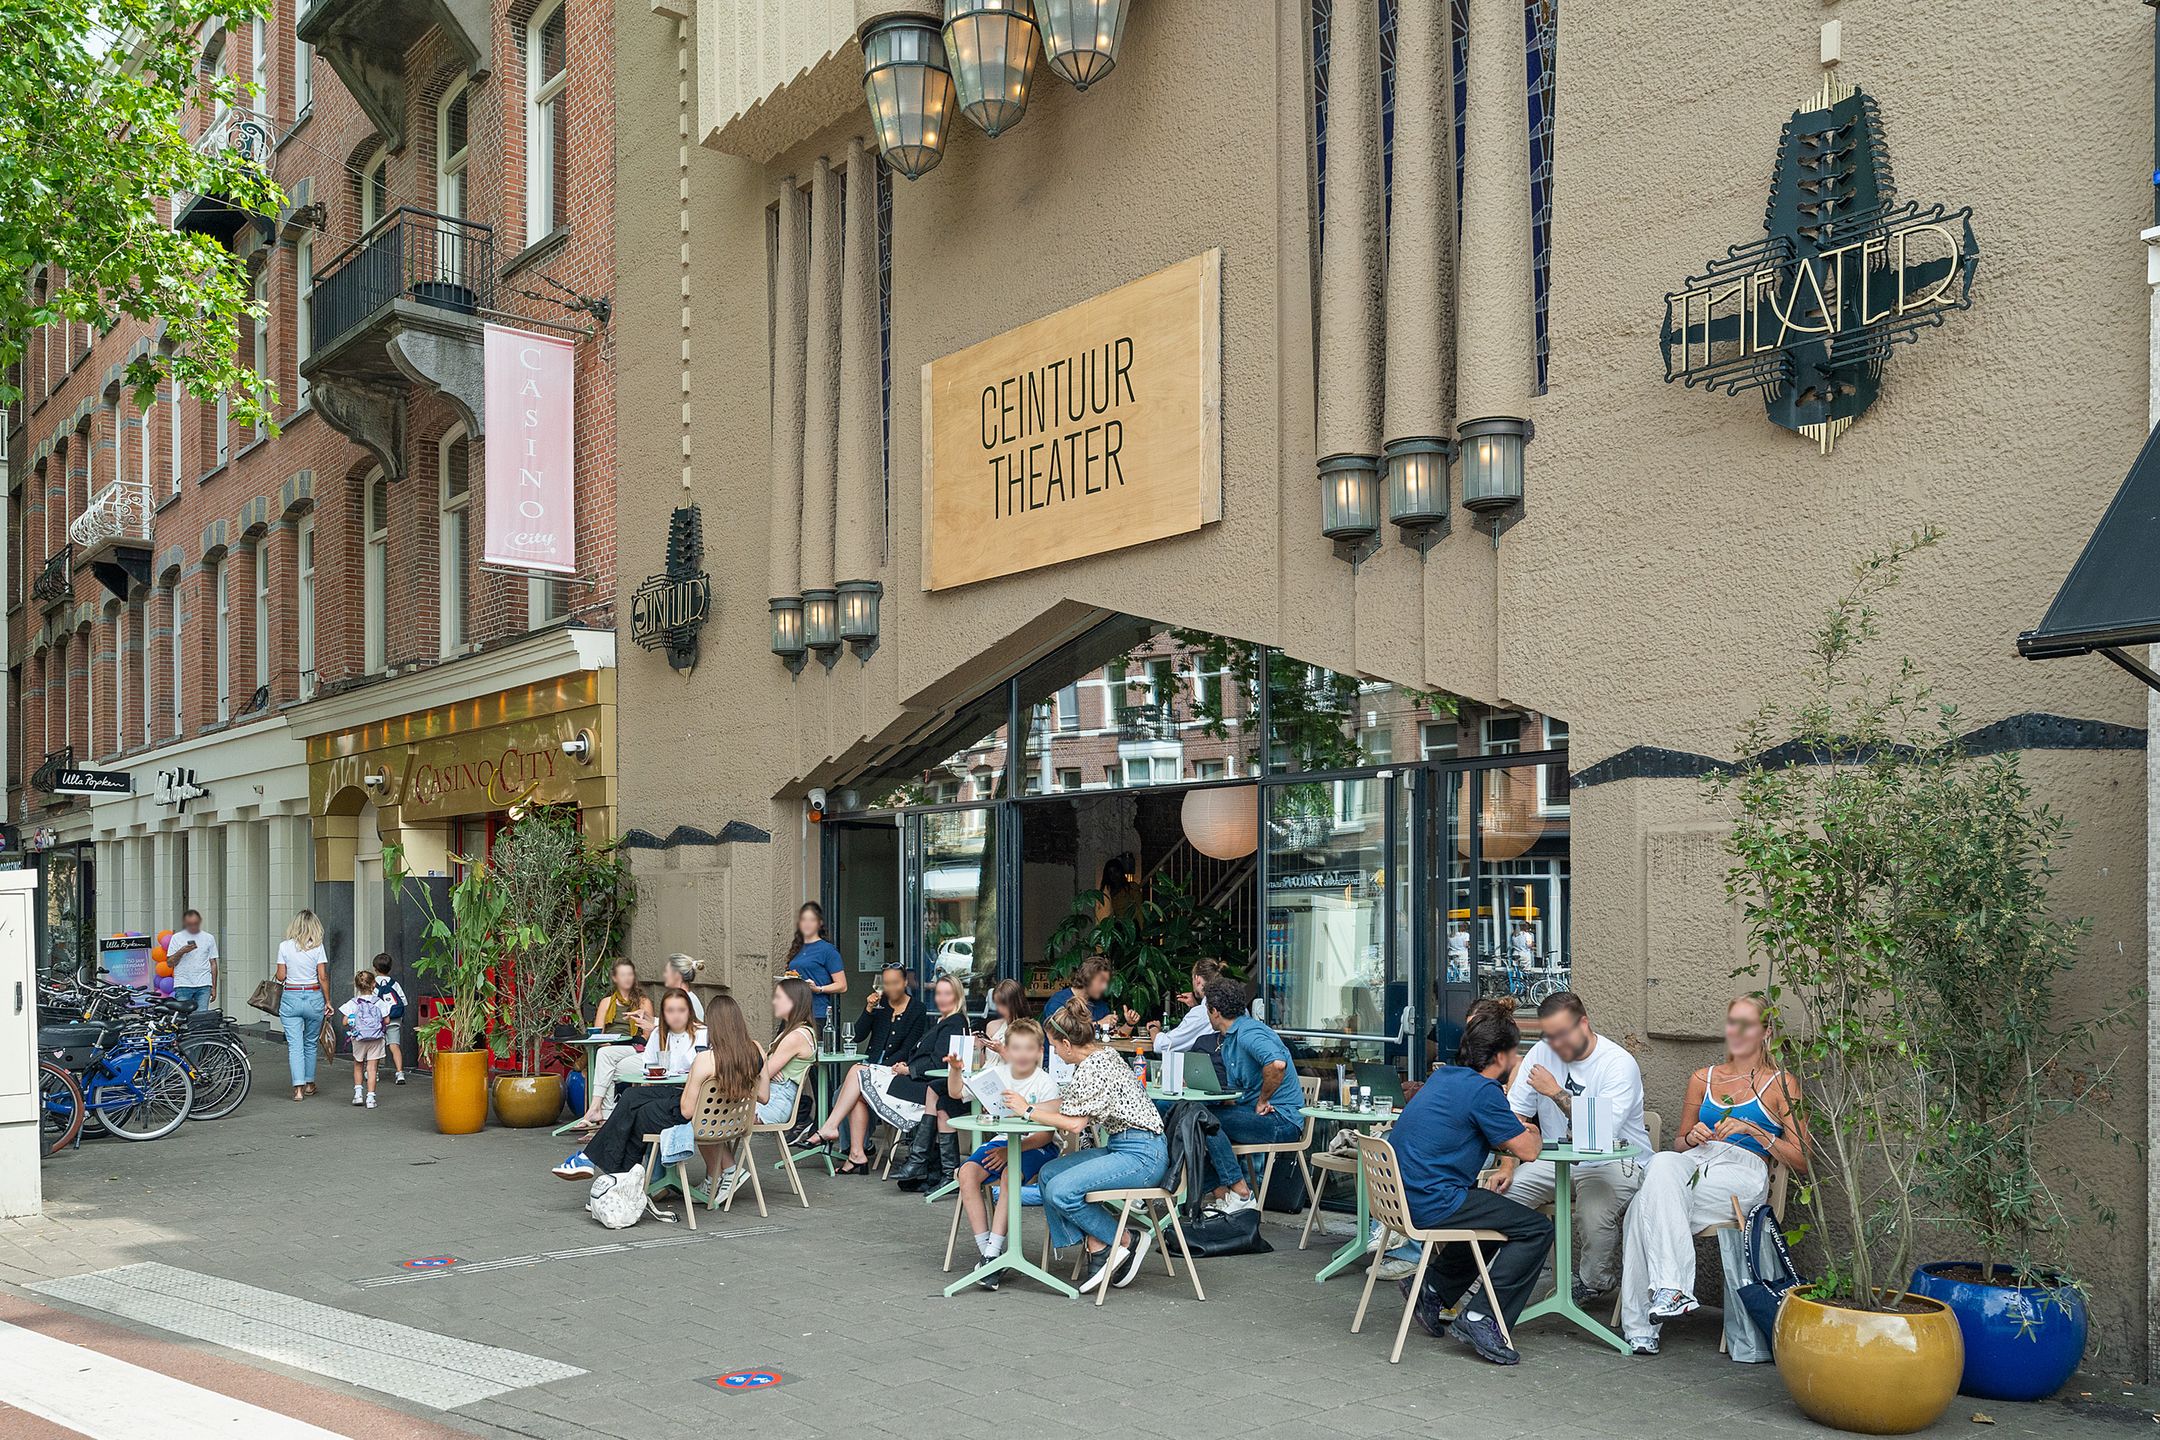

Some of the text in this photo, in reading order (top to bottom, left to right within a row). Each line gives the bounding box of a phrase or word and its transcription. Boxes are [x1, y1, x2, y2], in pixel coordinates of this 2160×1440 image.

[981, 337, 1136, 450] CEINTUUR
[519, 348, 545, 518] CASINO
[989, 420, 1125, 519] THEATER
[514, 532, 556, 546] City
[62, 772, 125, 789] Ulla Popken
[500, 748, 559, 793] CITY
[106, 941, 119, 949] Ulla
